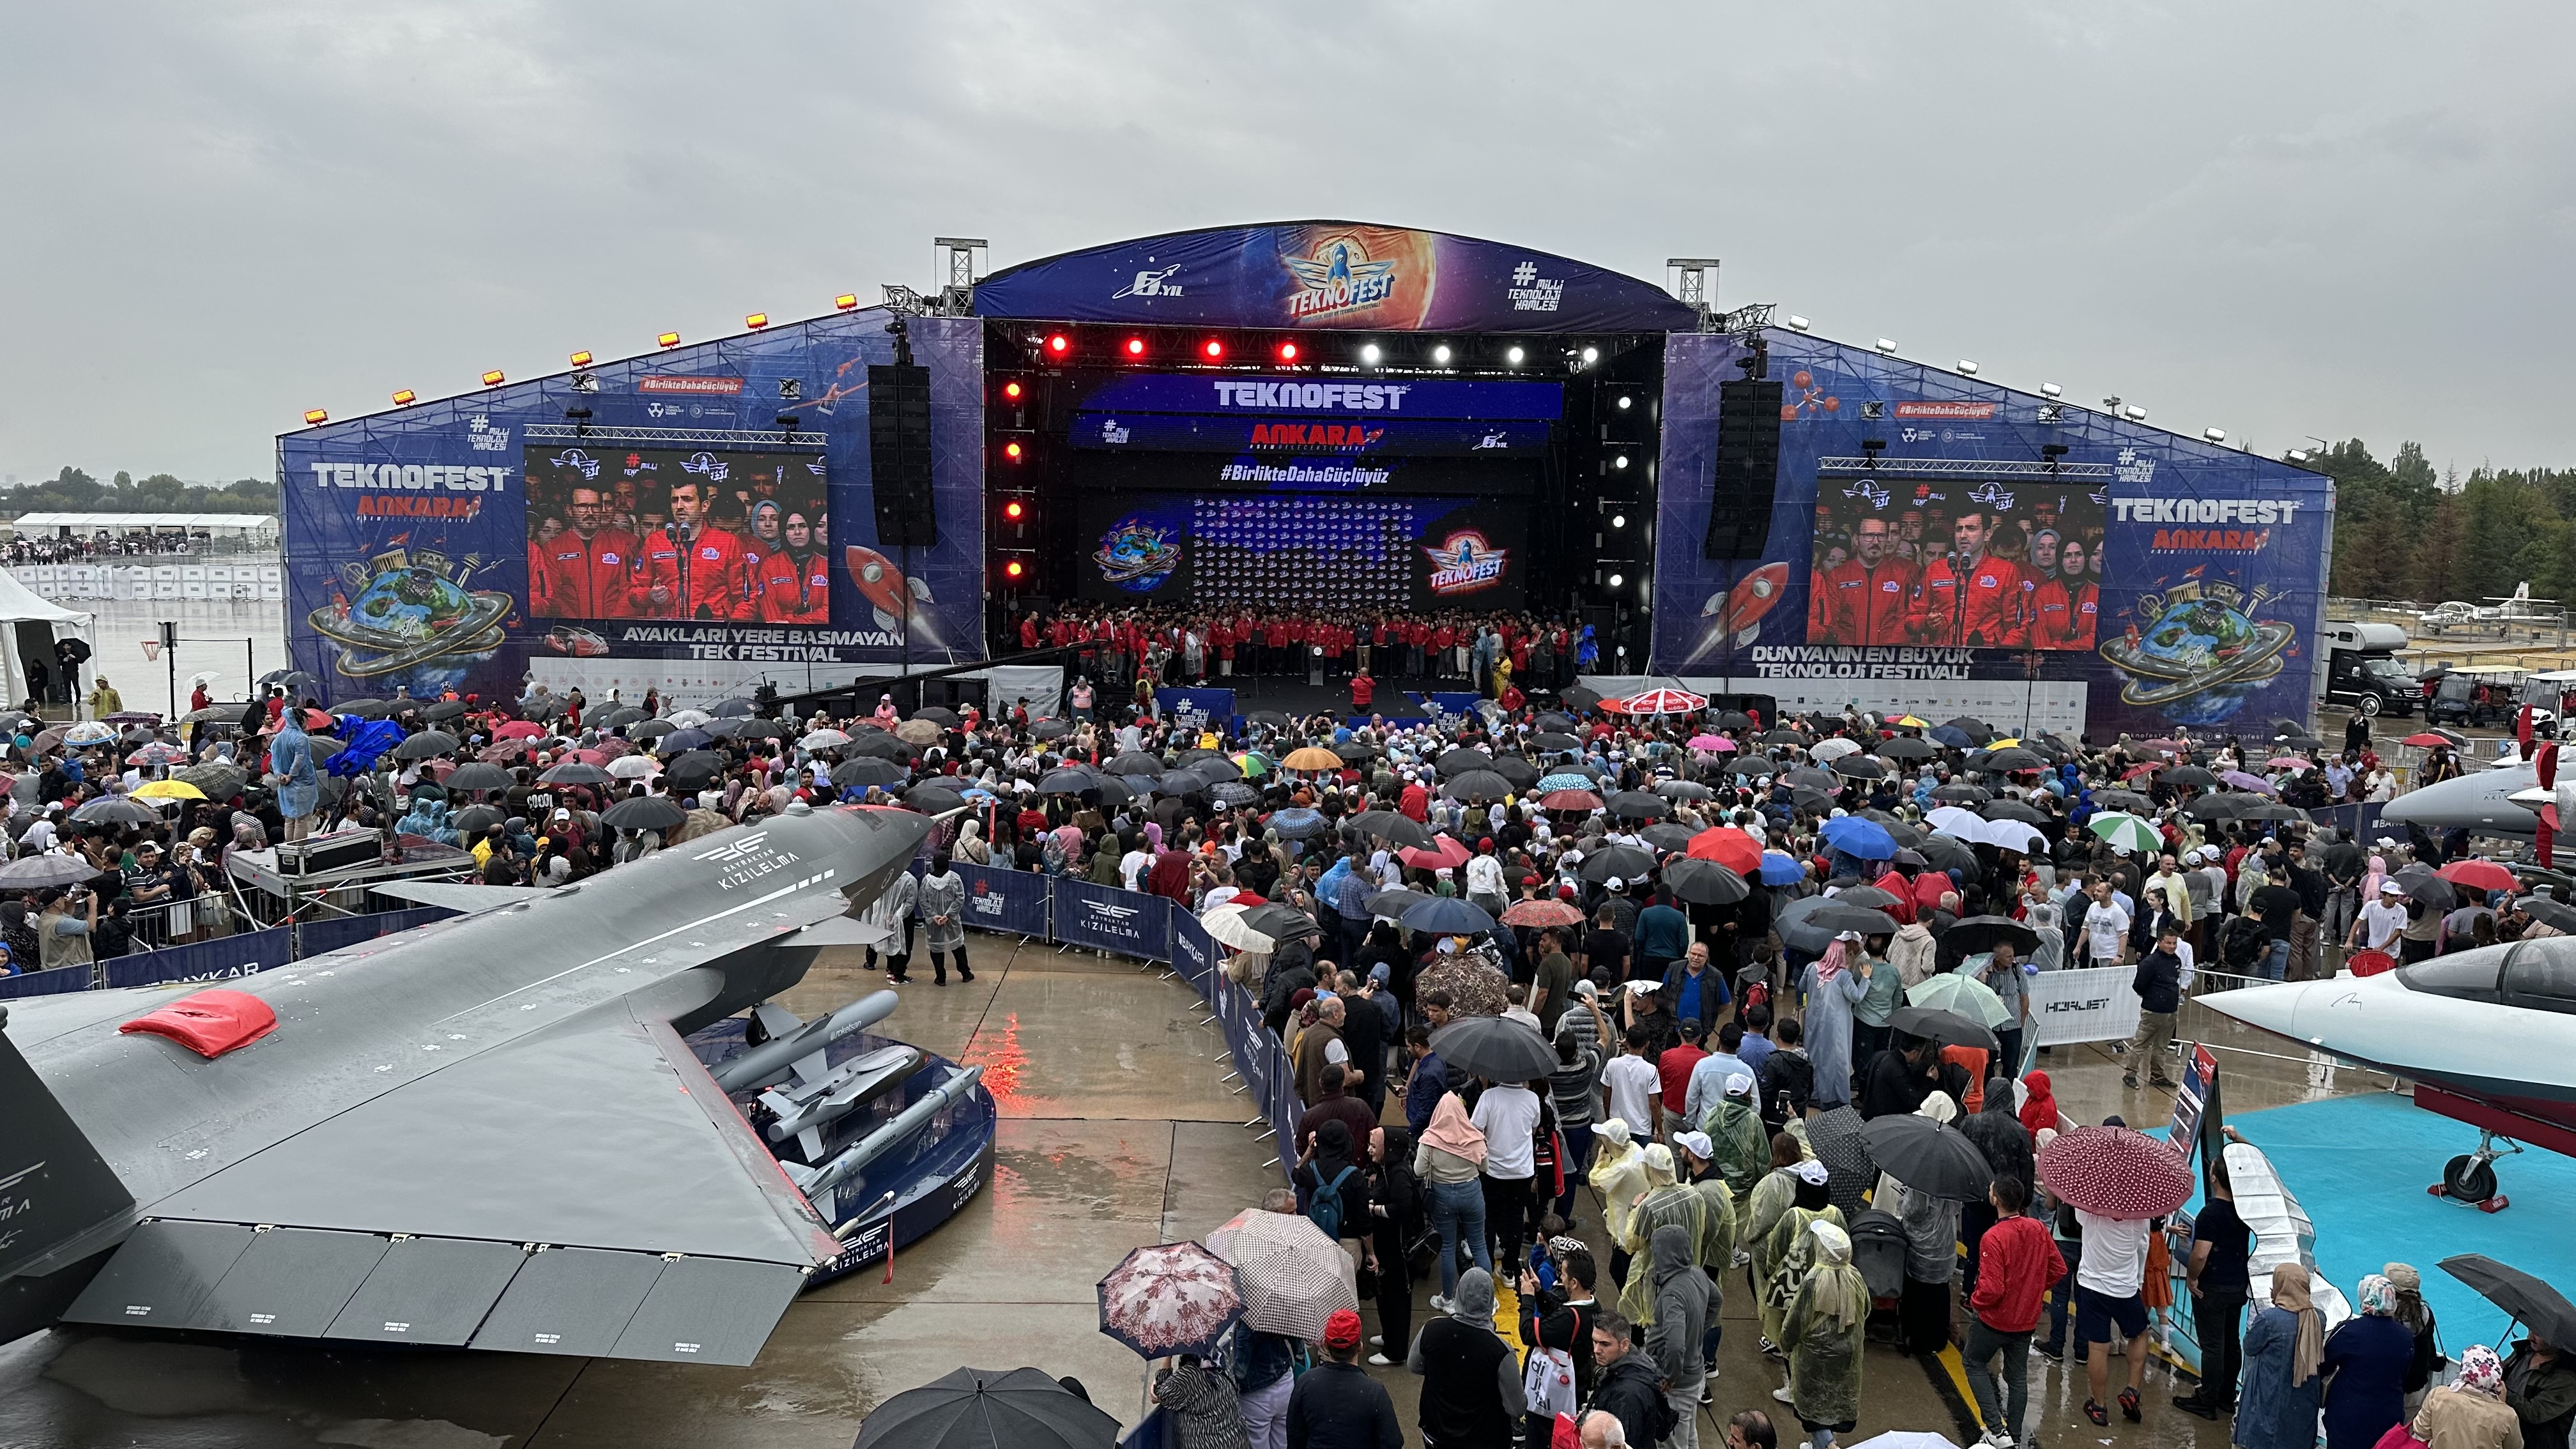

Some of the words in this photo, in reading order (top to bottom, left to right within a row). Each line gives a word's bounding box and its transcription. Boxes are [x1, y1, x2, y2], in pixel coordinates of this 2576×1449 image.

[1289, 273, 1394, 317] TEKNOFEST
[644, 379, 738, 392] #BirlikteDahaGüçlüyüz
[1214, 381, 1407, 410] TEKNOFEST
[1899, 405, 1990, 417] #BirlikteDahaGüçlüyüz
[1250, 424, 1365, 445] ANKARA
[310, 463, 510, 491] TEKNOFEST
[1220, 464, 1390, 487] #BirlikteDahaGüçlüyüz
[356, 495, 470, 518] ANKARA
[2112, 498, 2300, 524] TEKNOFEST
[2151, 529, 2256, 549] ANKARA
[1431, 560, 1503, 587] TEKNOFEST
[623, 627, 728, 643] AYAKLARI
[730, 629, 786, 644] YERE
[788, 630, 905, 646] BASMAYAN
[689, 644, 734, 659] TEK
[1865, 647, 1890, 663] EN
[717, 852, 799, 890] KIZILELMA
[723, 848, 775, 873] BAYRAKTAR
[1080, 919, 1140, 939] KIZILELMA
[1091, 914, 1130, 926] BAYRAKTAR
[1182, 935, 1204, 967] BAYKAR
[836, 1020, 862, 1039] roketsan
[831, 1241, 889, 1272] KIZILELMA
[842, 1238, 880, 1259] BAYRAKTAR
